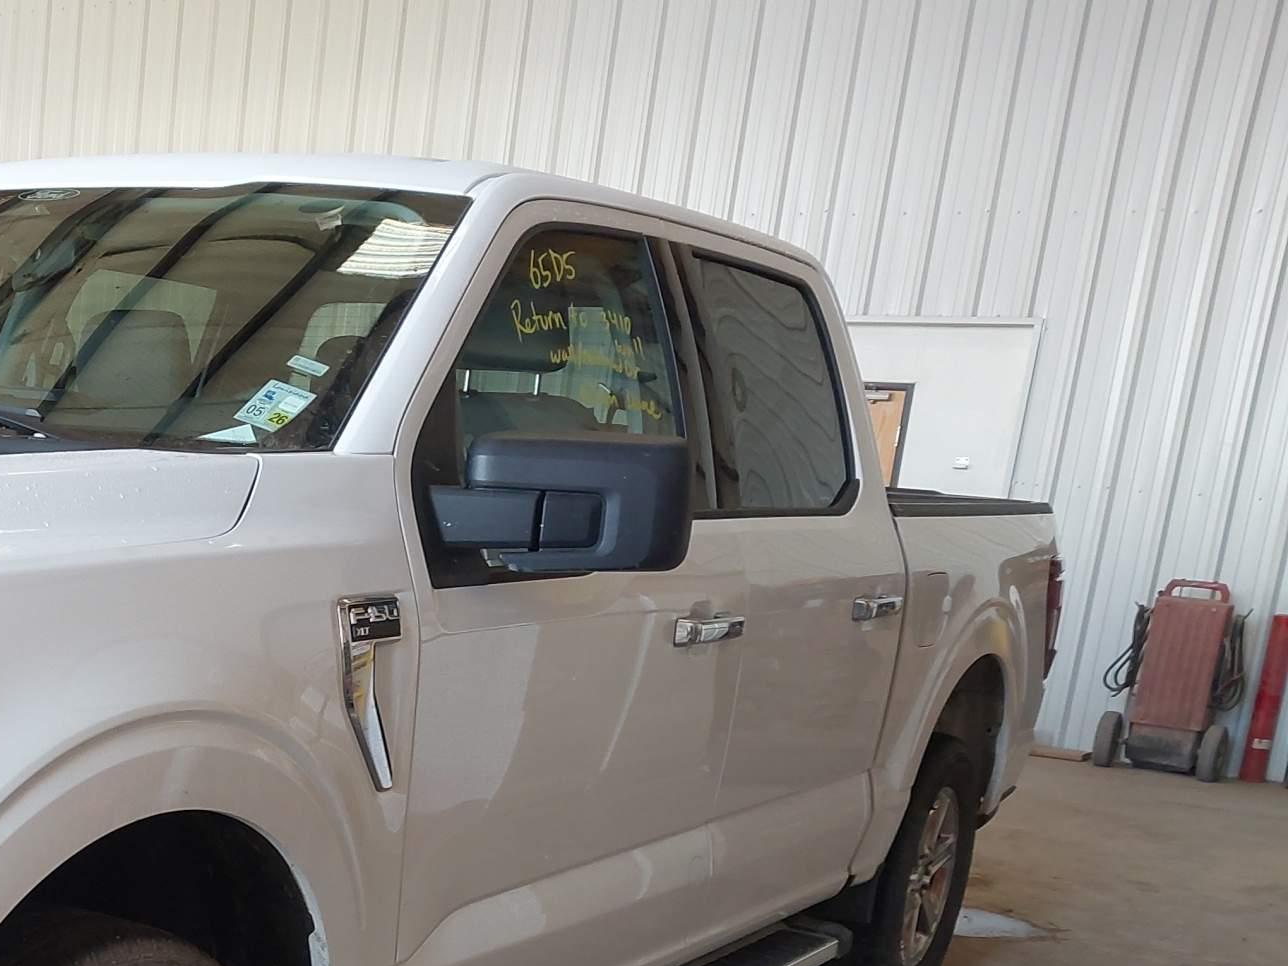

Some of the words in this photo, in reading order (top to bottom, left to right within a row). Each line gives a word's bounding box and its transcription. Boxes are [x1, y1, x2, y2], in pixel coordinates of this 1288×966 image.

[510, 299, 568, 343] Return
[245, 404, 266, 417] 05
[268, 412, 289, 425] 26
